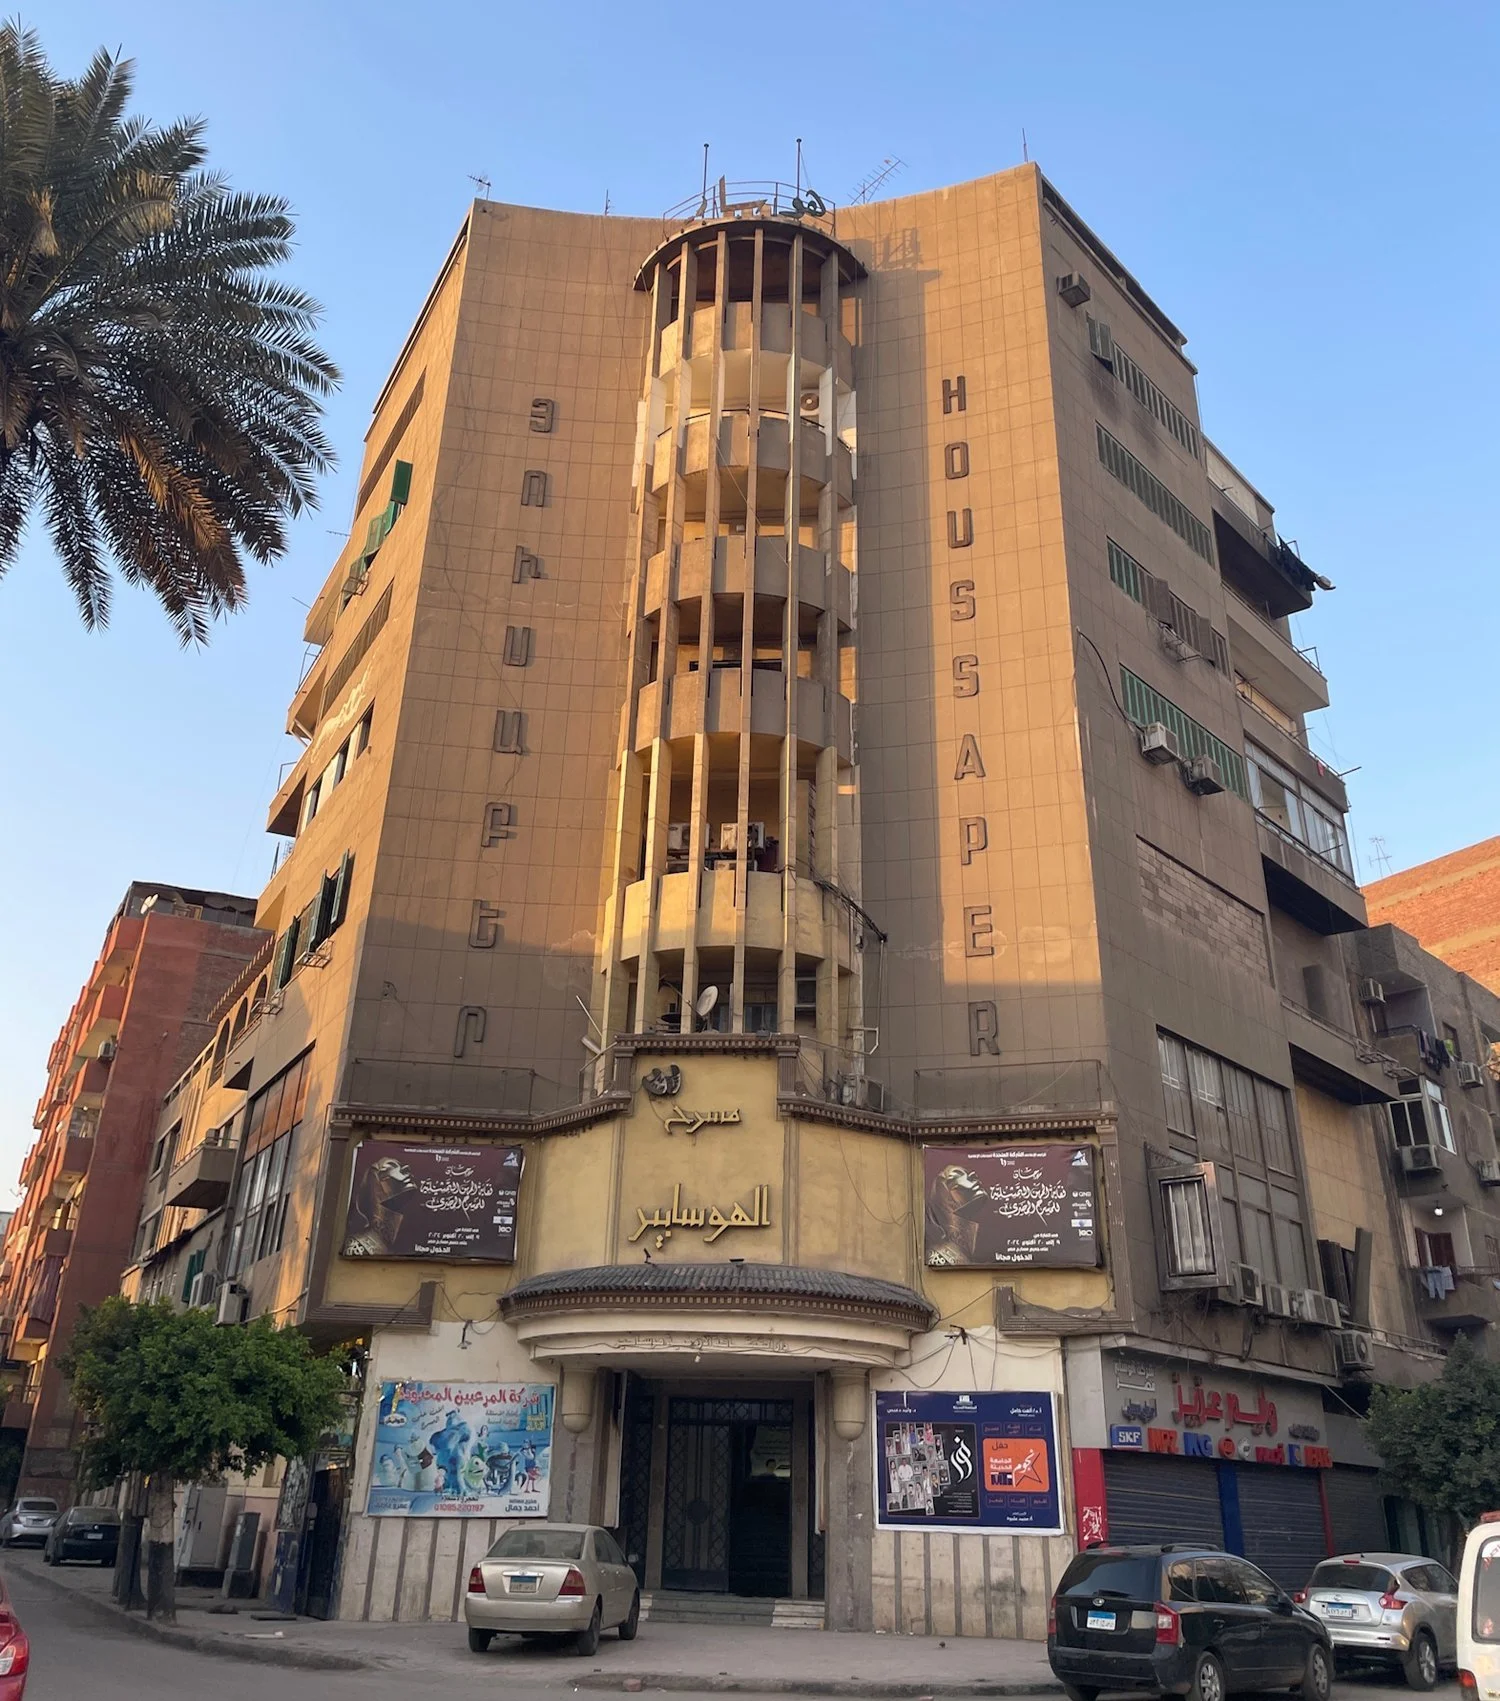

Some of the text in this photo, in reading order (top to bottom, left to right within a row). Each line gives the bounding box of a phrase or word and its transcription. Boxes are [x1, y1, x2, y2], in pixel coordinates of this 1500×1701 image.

[942, 375, 1000, 1057] HOUSSAPER
[664, 1104, 741, 1135] مسرح
[627, 1184, 771, 1249] الهوسابير
[1011, 1253, 1033, 1263] الدخول
[454, 1387, 507, 1408] المرعبين
[509, 1387, 541, 1408] شركة
[991, 1441, 1008, 1451] حفل
[1118, 1431, 1141, 1443] SKF
[1012, 1448, 1035, 1488] نجوم
